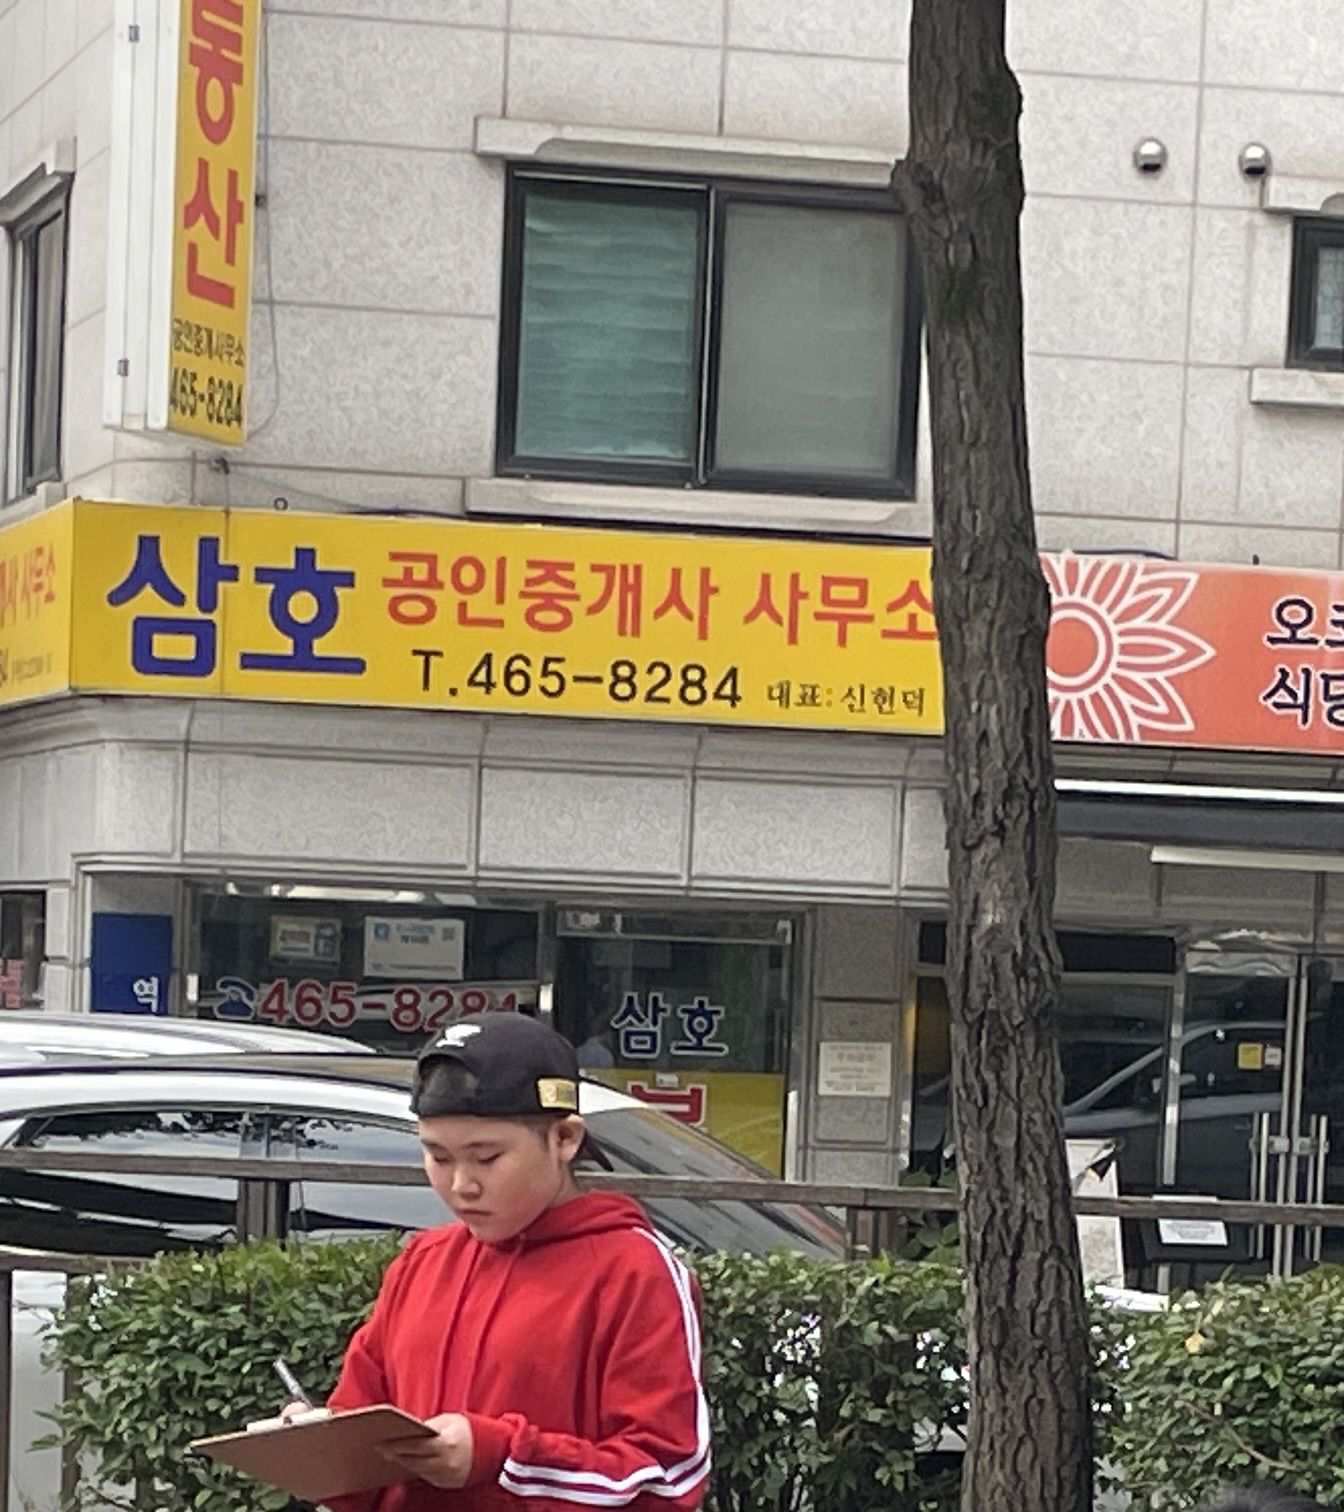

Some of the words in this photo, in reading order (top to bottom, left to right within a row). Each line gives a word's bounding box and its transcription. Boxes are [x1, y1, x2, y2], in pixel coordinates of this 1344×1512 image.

[106, 534, 367, 678] 삼호
[381, 550, 719, 641] 공인중개사
[742, 571, 939, 648] 사무소
[412, 649, 743, 709] T.465-8284
[611, 990, 730, 1060] 삼호
